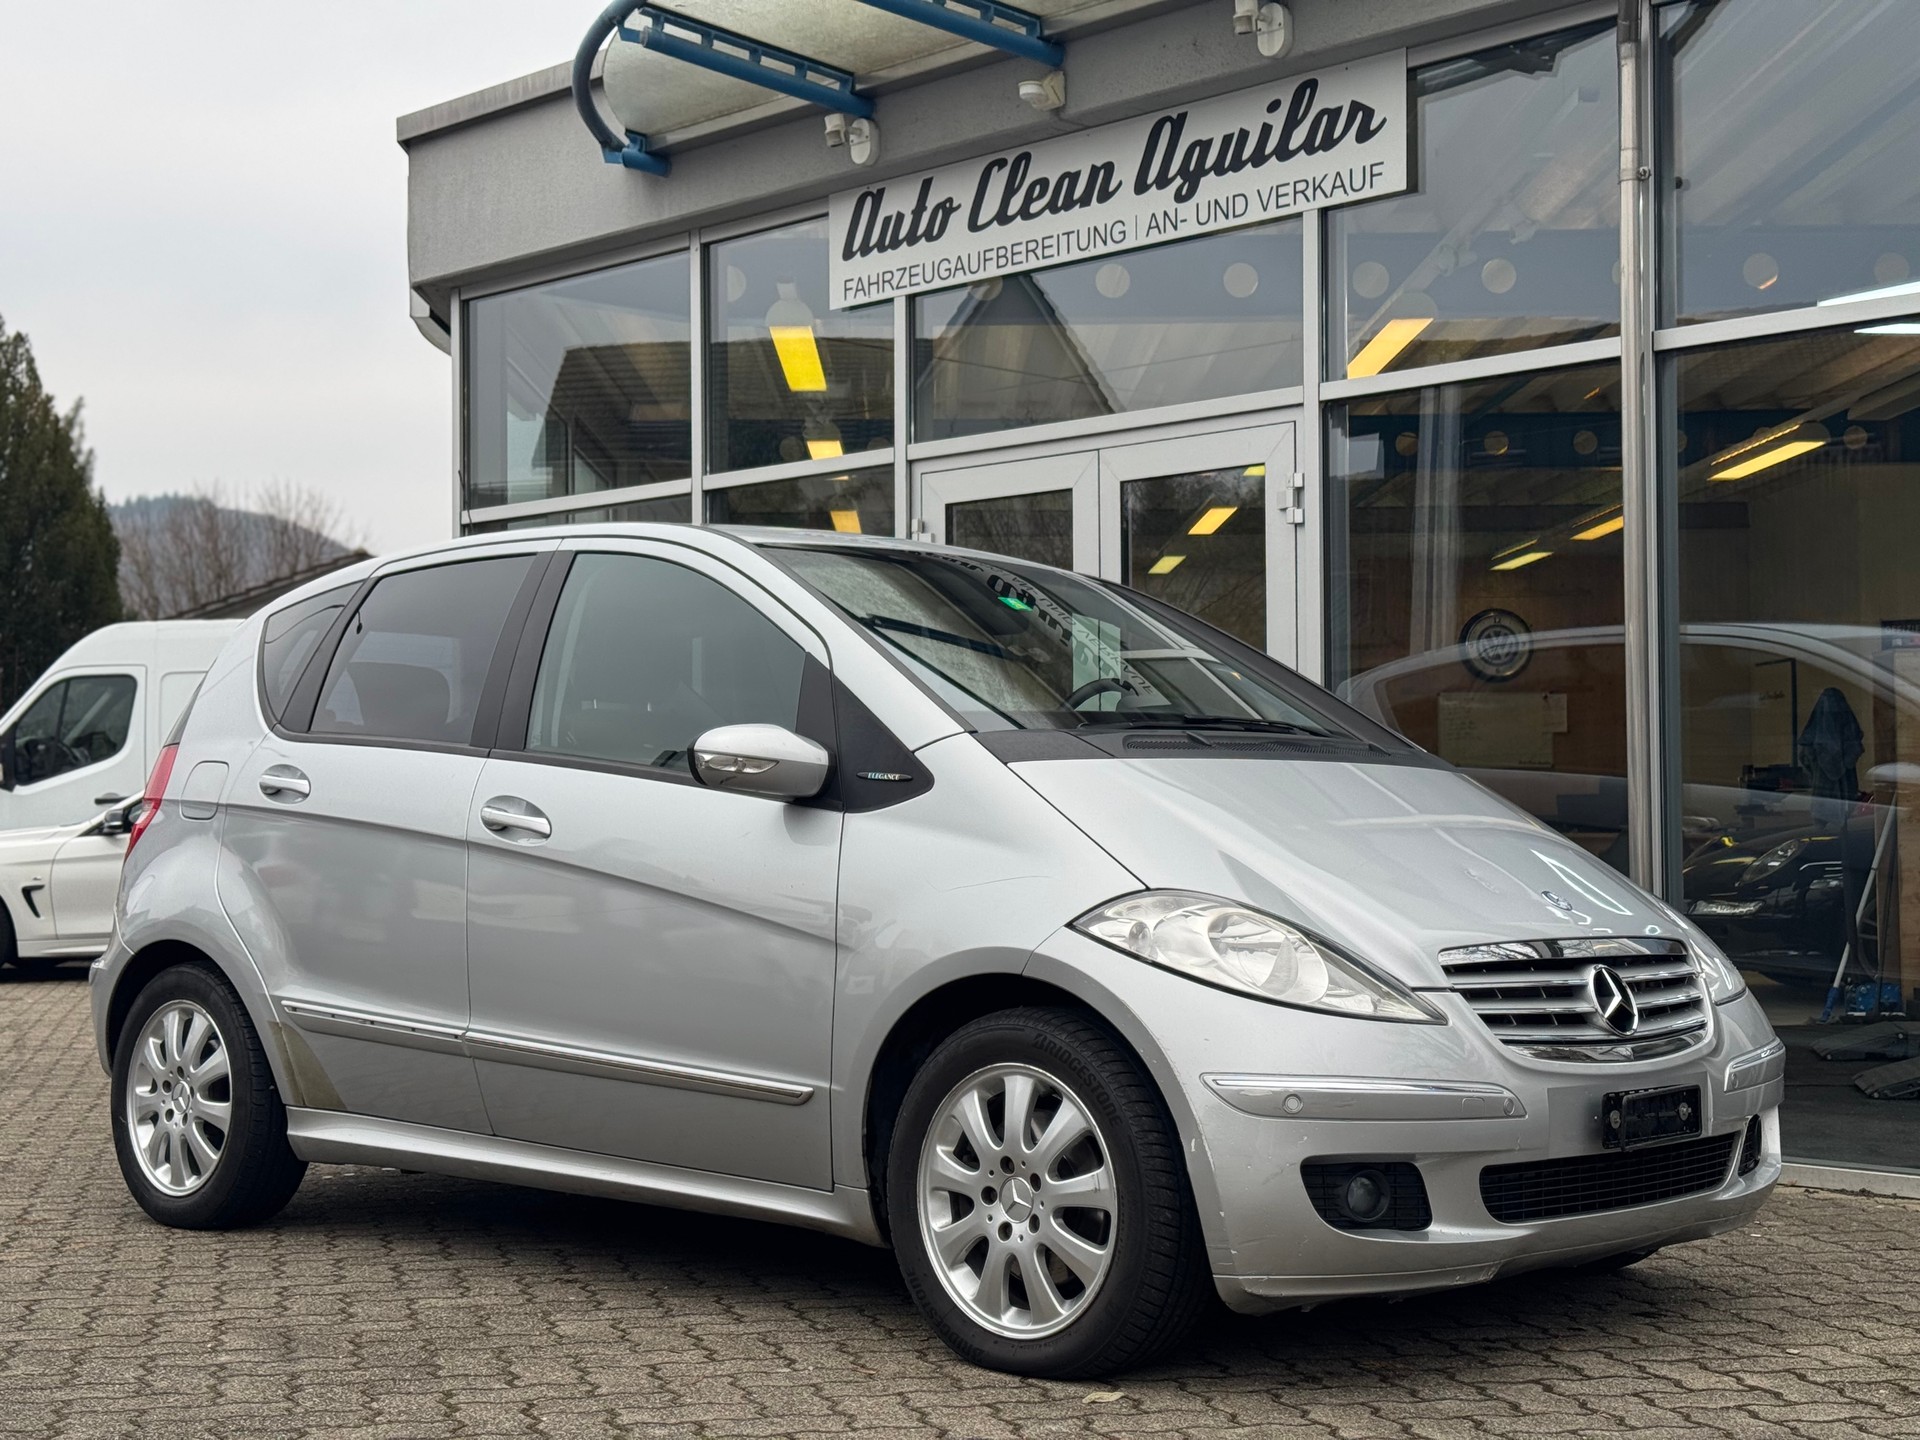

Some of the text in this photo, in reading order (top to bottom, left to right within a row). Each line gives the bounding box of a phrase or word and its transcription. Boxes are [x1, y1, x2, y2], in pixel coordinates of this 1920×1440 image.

[842, 78, 1388, 261] Auto Clean Aguilar
[844, 161, 1384, 301] FAHRZEUGAUFBEREITUNG AN- UND VERKAUF
[867, 772, 900, 781] ELEGANCE
[1032, 1032, 1123, 1127] BRIDGESTONE
